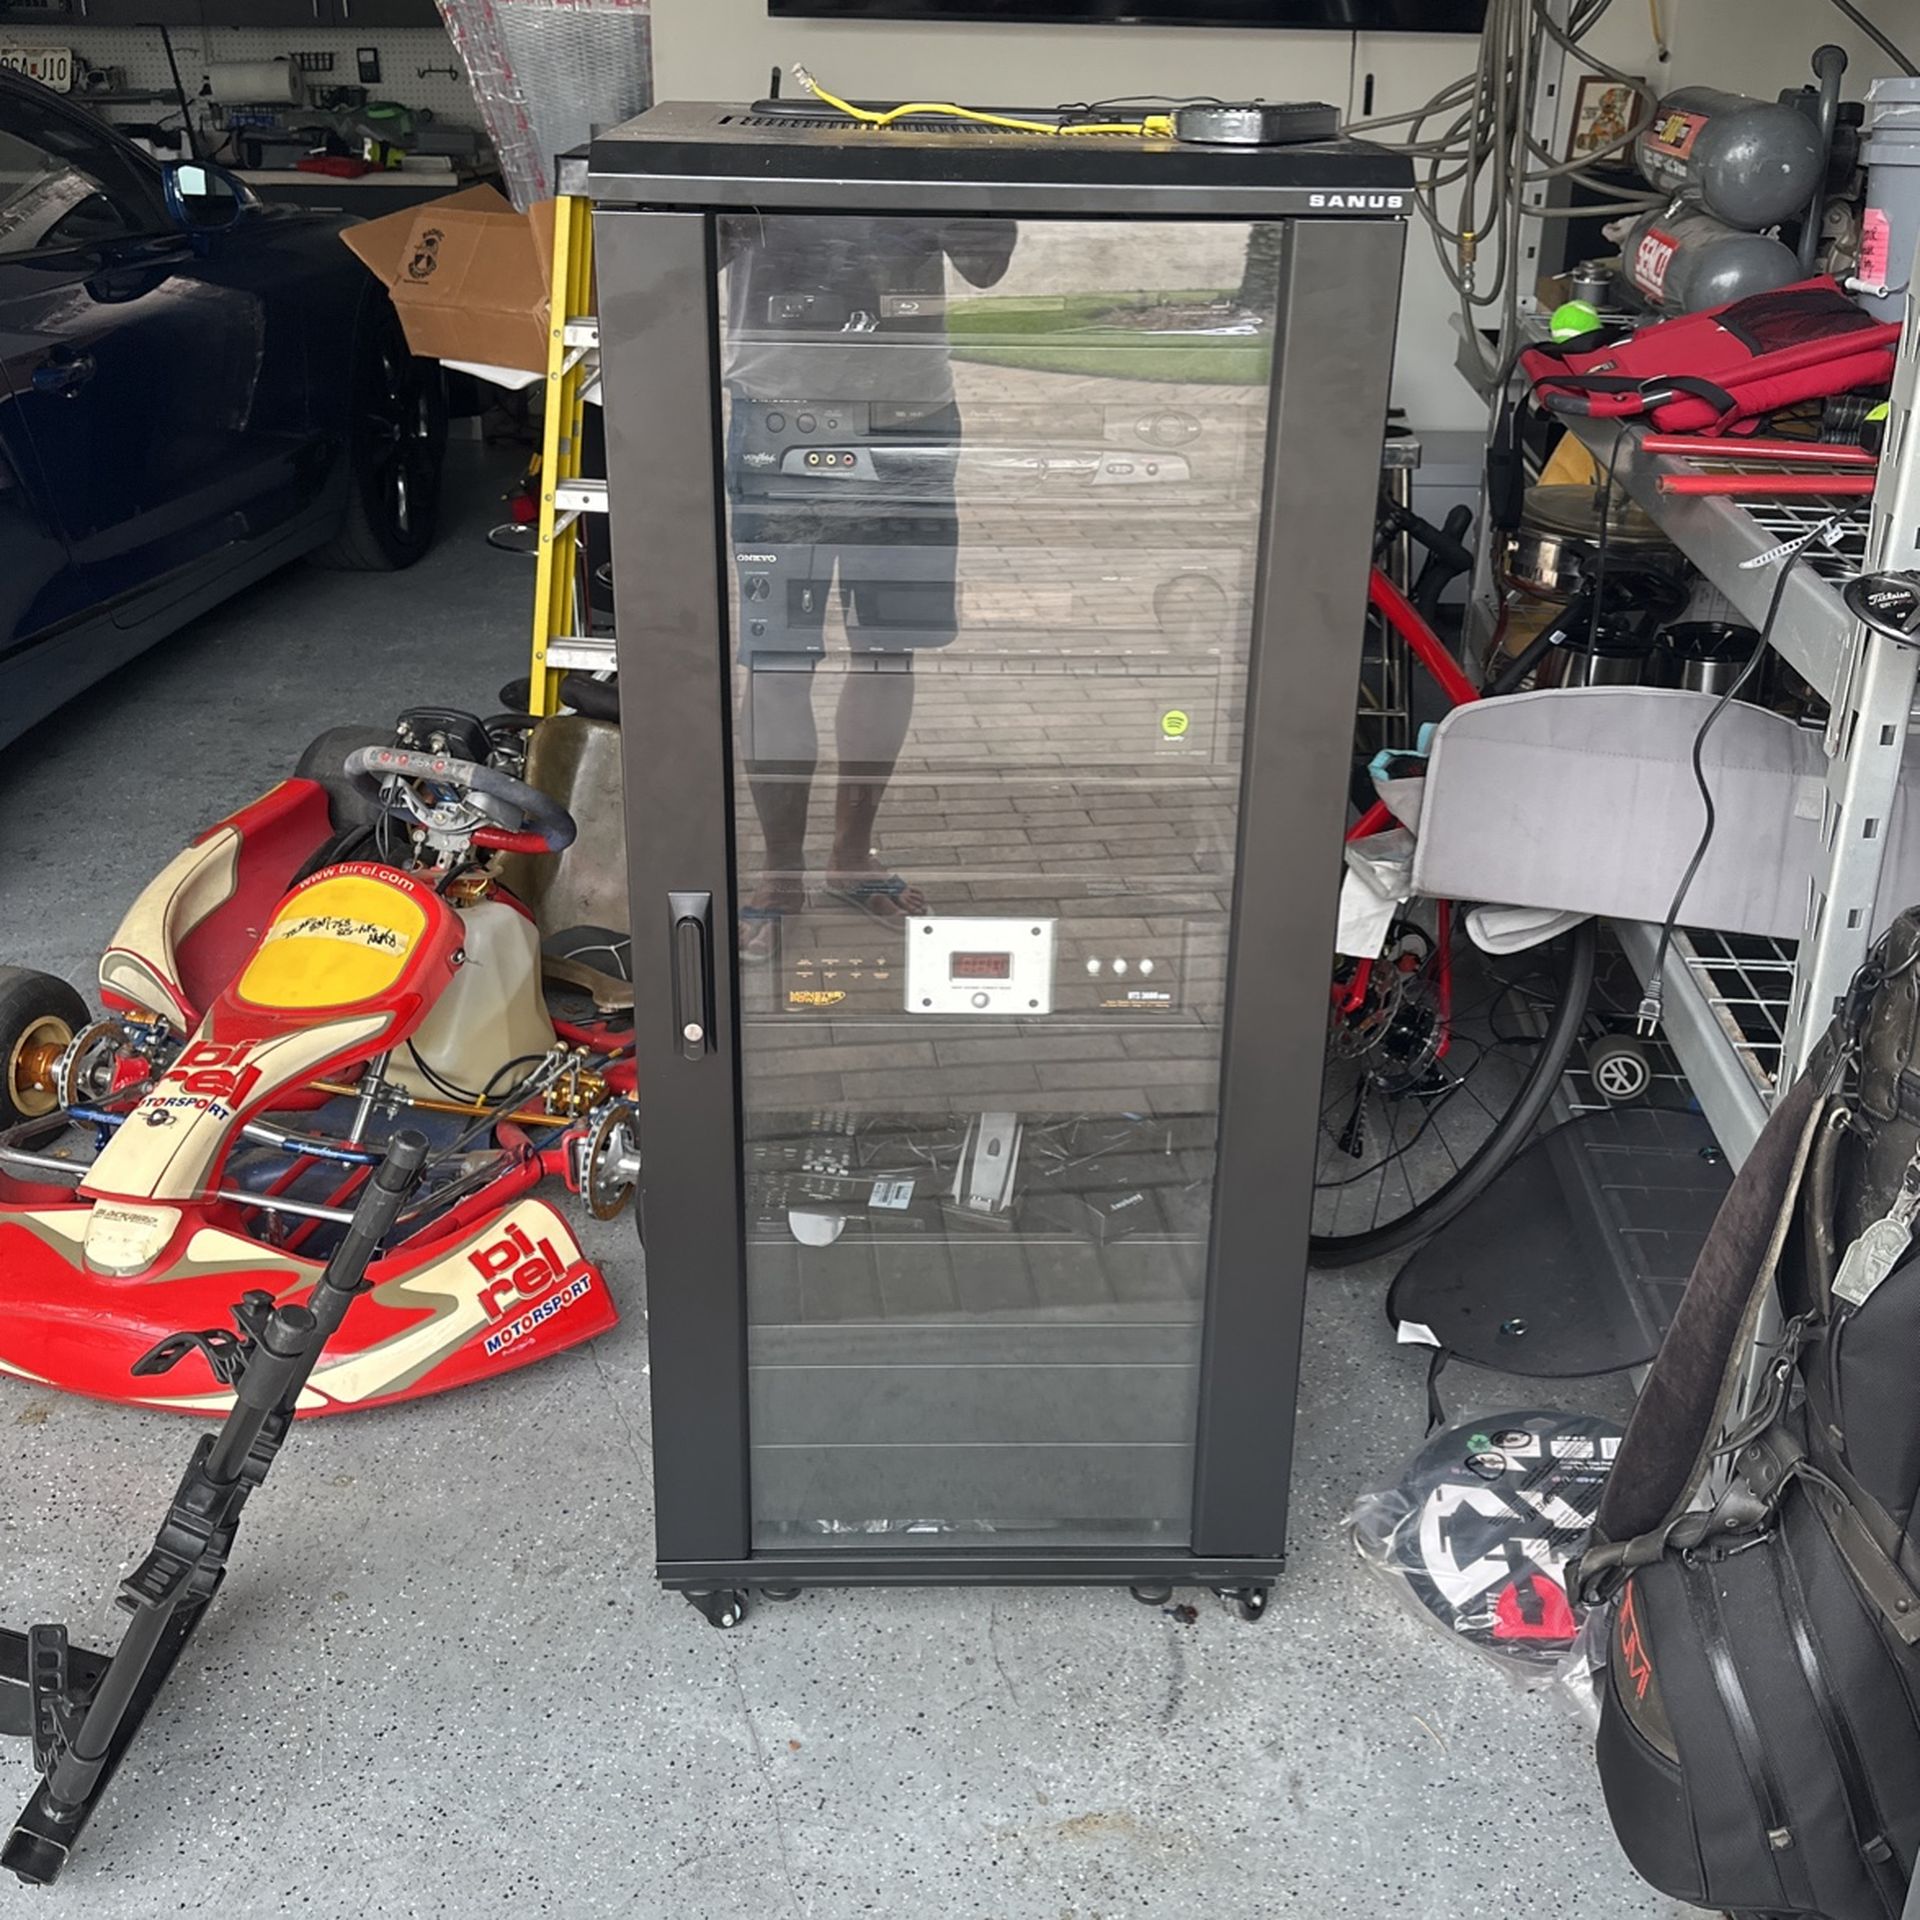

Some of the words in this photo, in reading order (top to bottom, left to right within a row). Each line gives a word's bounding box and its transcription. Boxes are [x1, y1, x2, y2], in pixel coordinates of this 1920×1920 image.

[1308, 194, 1403, 208] SANUS
[736, 554, 777, 563] ONKYO
[299, 863, 415, 892] www.birel.com
[175, 1040, 260, 1068] bi
[467, 1222, 537, 1282] bi
[477, 1237, 567, 1321] rel
[485, 1274, 592, 1355] MOTORSPORT
